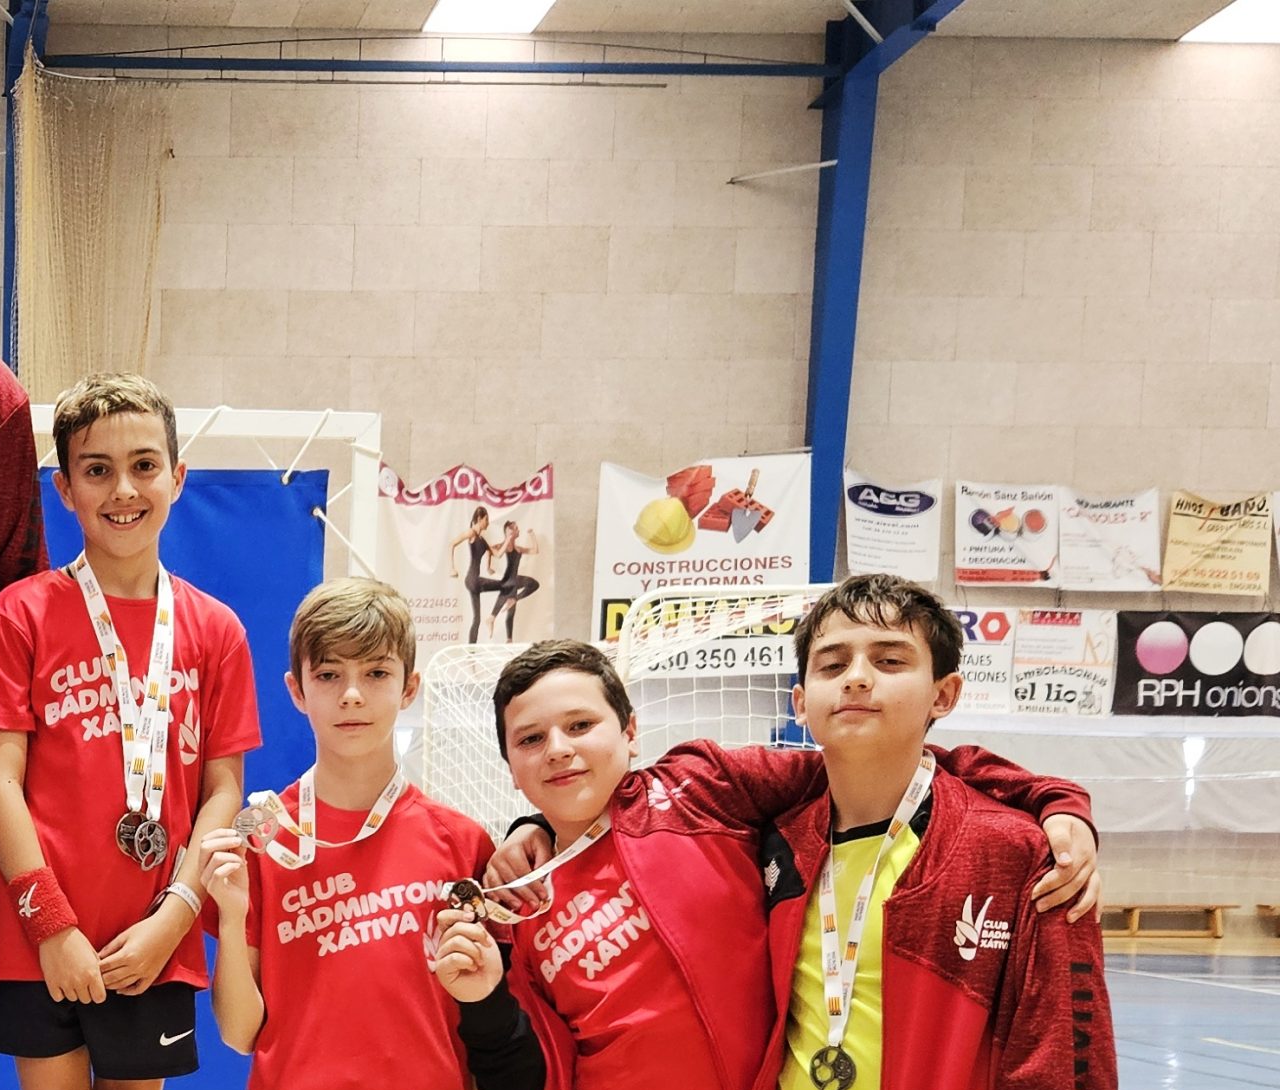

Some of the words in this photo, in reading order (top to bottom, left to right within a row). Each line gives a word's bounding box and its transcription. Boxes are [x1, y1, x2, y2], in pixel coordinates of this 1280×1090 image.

[612, 555, 793, 576] CONSTRUCCIONES
[641, 579, 651, 592] Y
[657, 574, 764, 587] REFORMAS
[695, 648, 736, 669] 350
[744, 645, 783, 667] 461
[1015, 682, 1036, 701] el
[1137, 678, 1201, 707] RPH
[282, 873, 356, 913] CLUB
[534, 890, 596, 951] CLUB
[983, 919, 1009, 930] CLUB
[981, 929, 1011, 940] BADM
